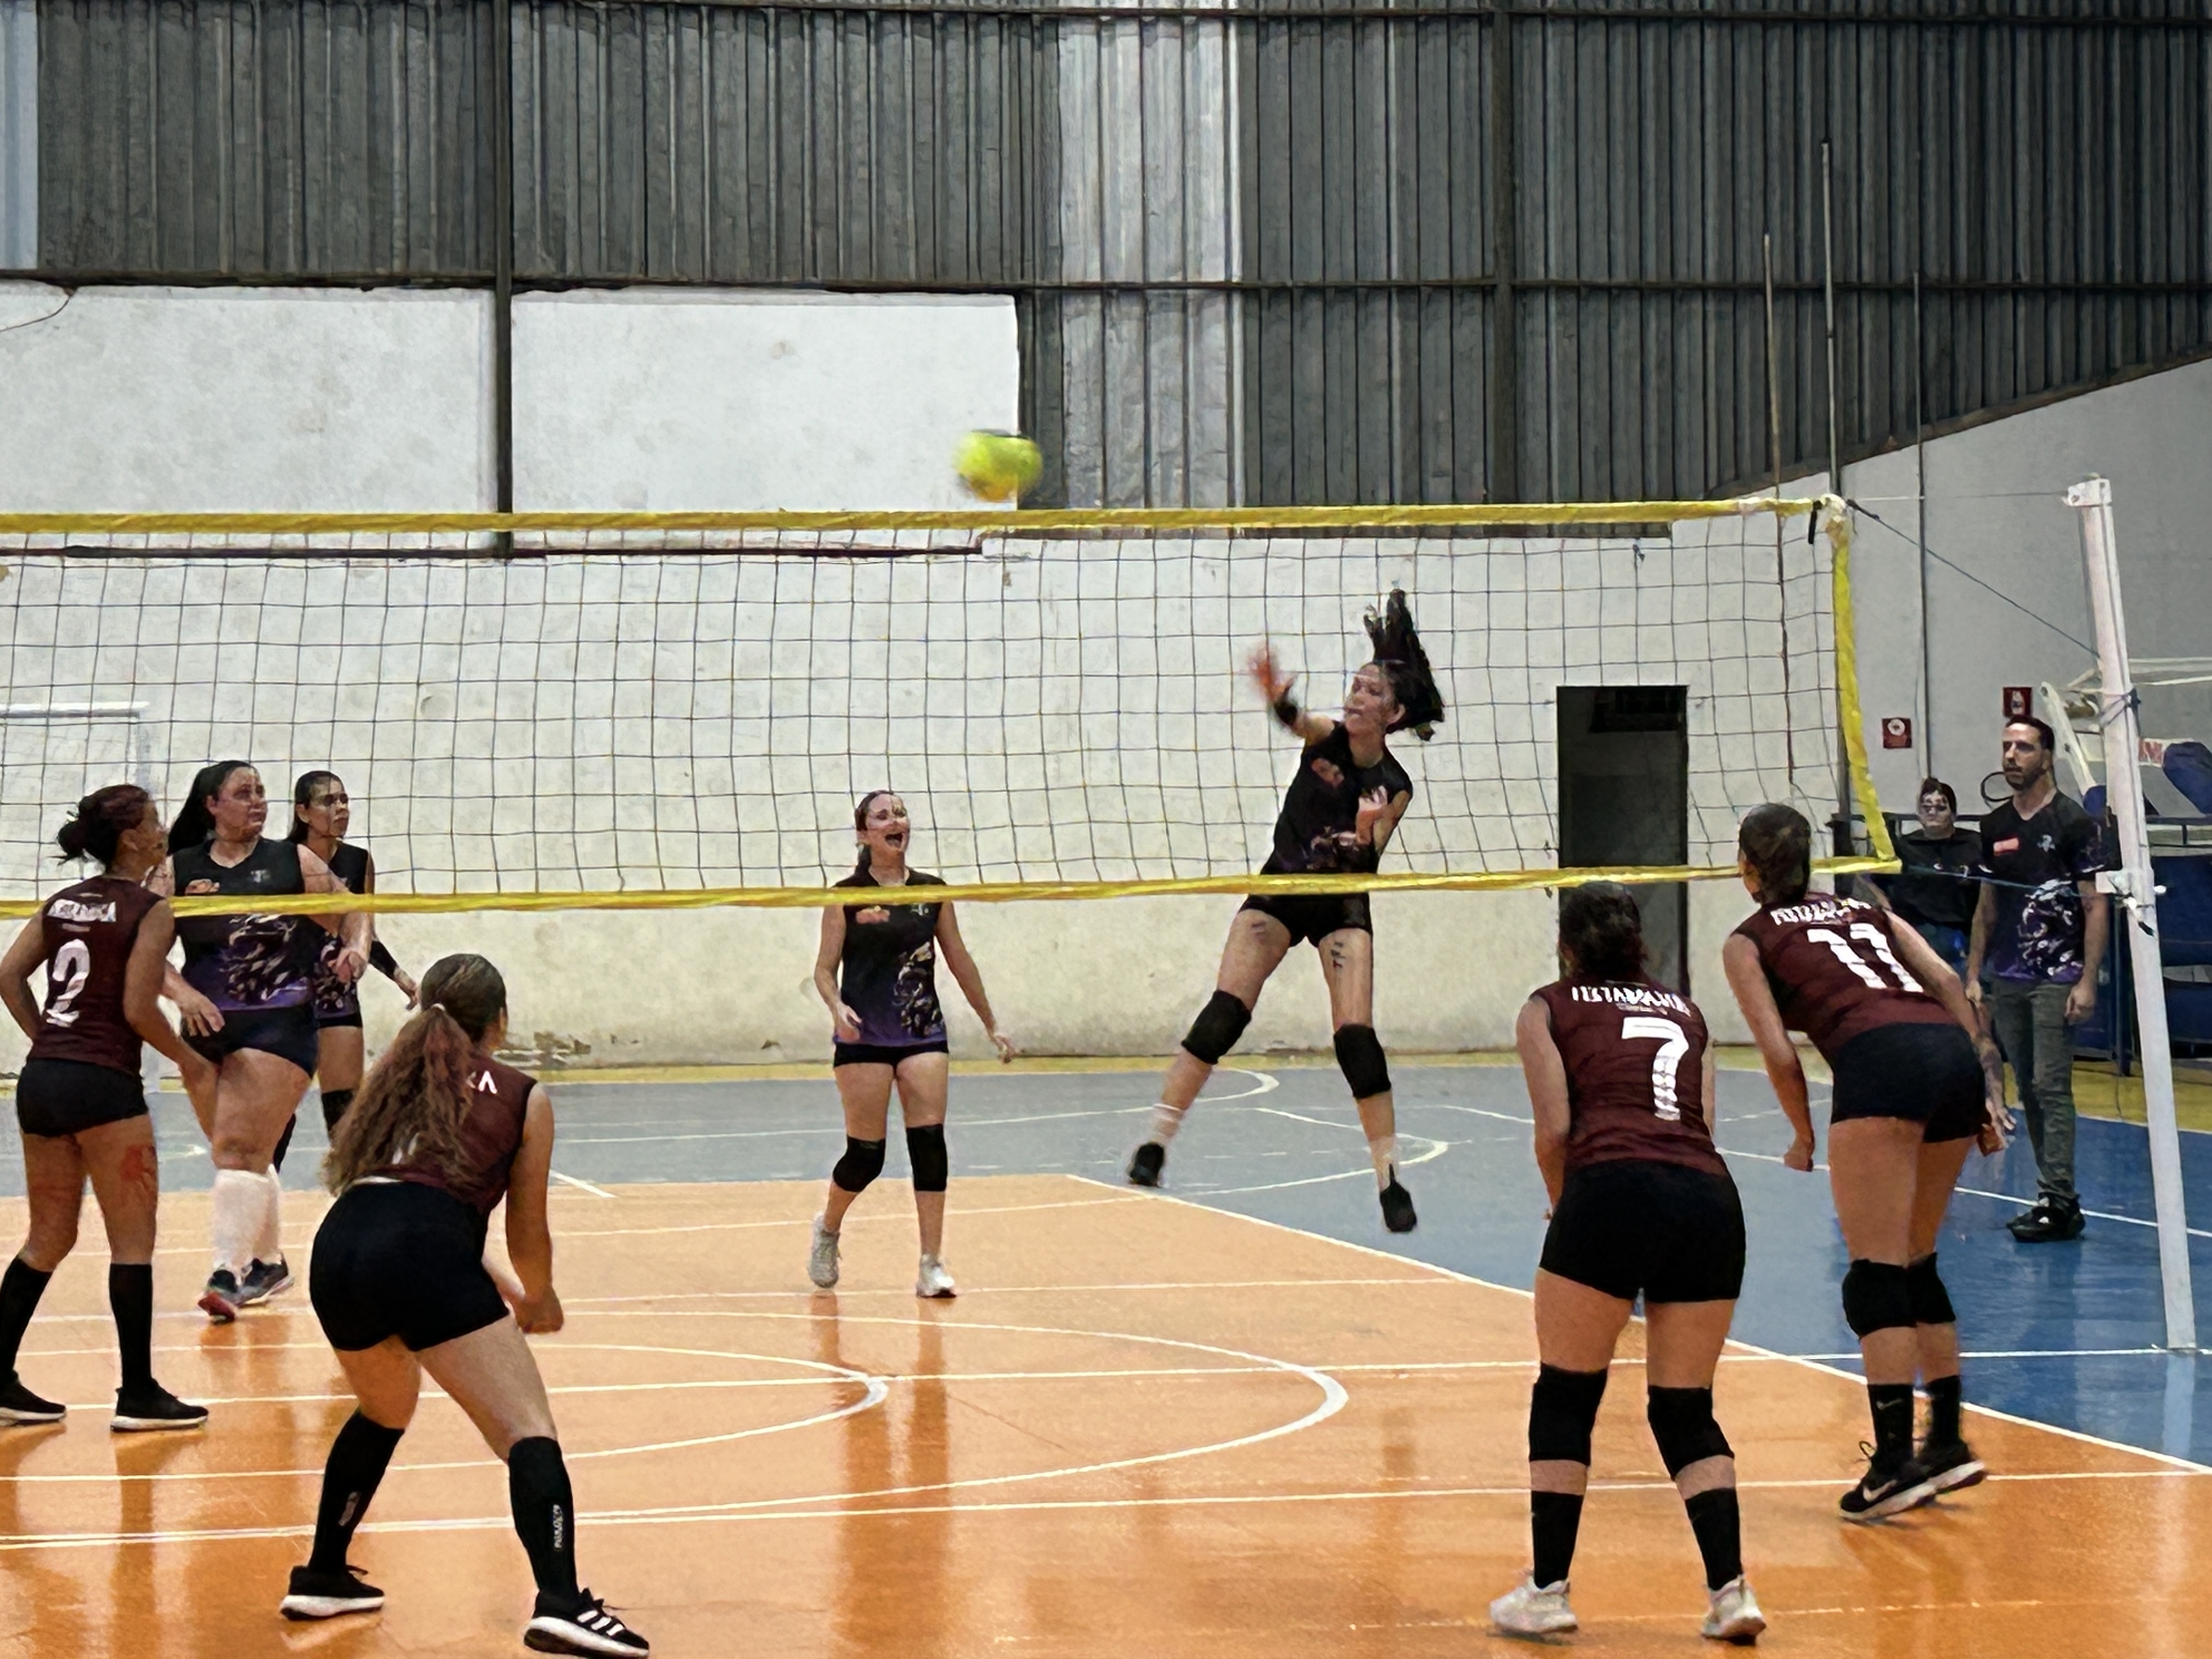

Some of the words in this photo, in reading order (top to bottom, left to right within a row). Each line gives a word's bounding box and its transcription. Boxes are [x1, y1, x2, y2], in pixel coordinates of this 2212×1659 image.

[47, 939, 89, 1027] 2
[1807, 923, 1924, 993] 11
[1621, 1016, 1690, 1121] 7
